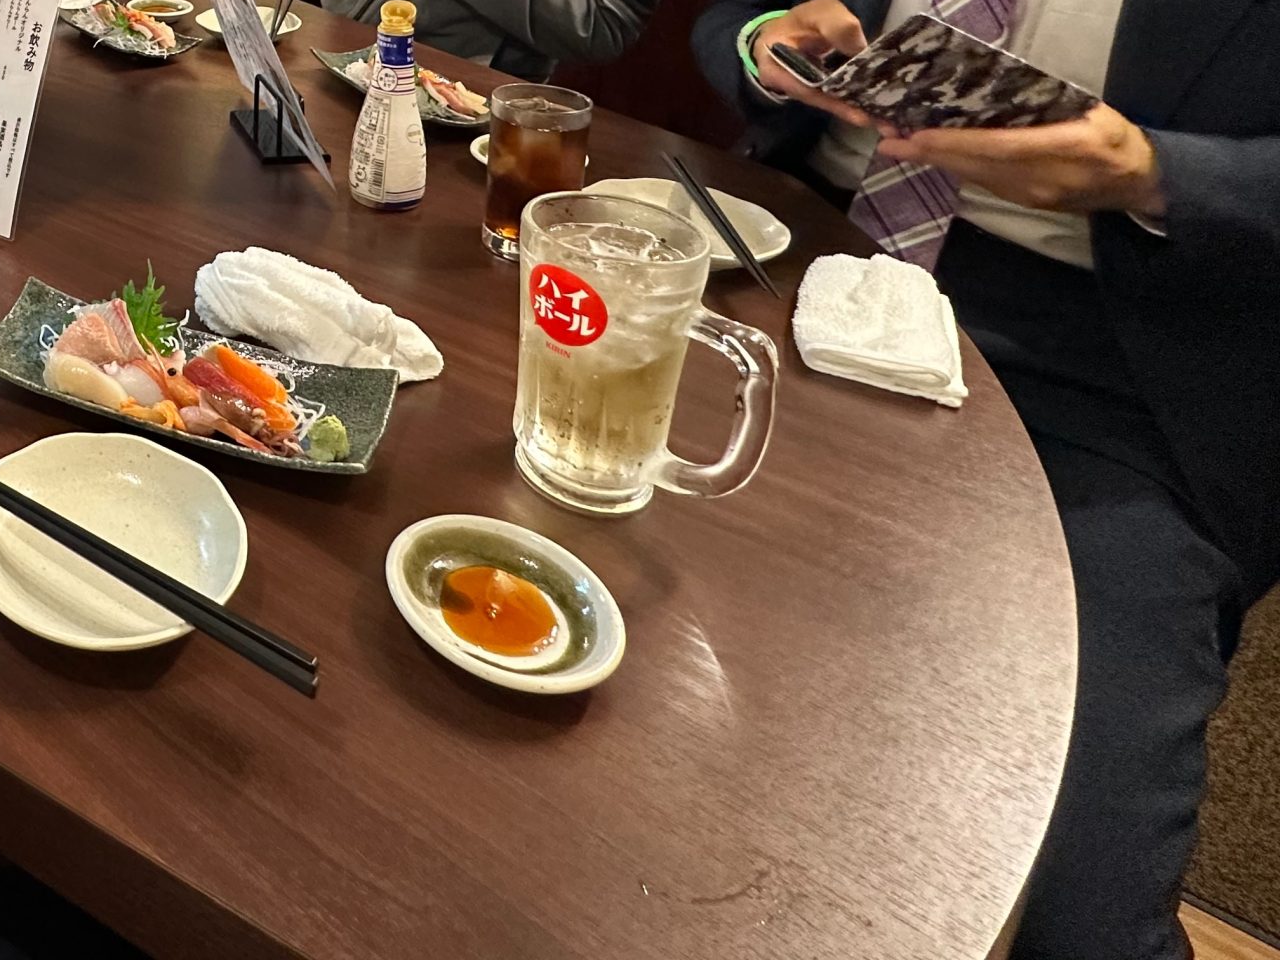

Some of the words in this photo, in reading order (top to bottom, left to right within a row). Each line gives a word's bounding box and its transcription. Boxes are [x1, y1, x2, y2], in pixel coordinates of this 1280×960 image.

[22, 21, 42, 72] お飲み物
[538, 273, 589, 310] ハイ
[534, 294, 596, 336] ボール
[546, 341, 571, 359] KIRIN
